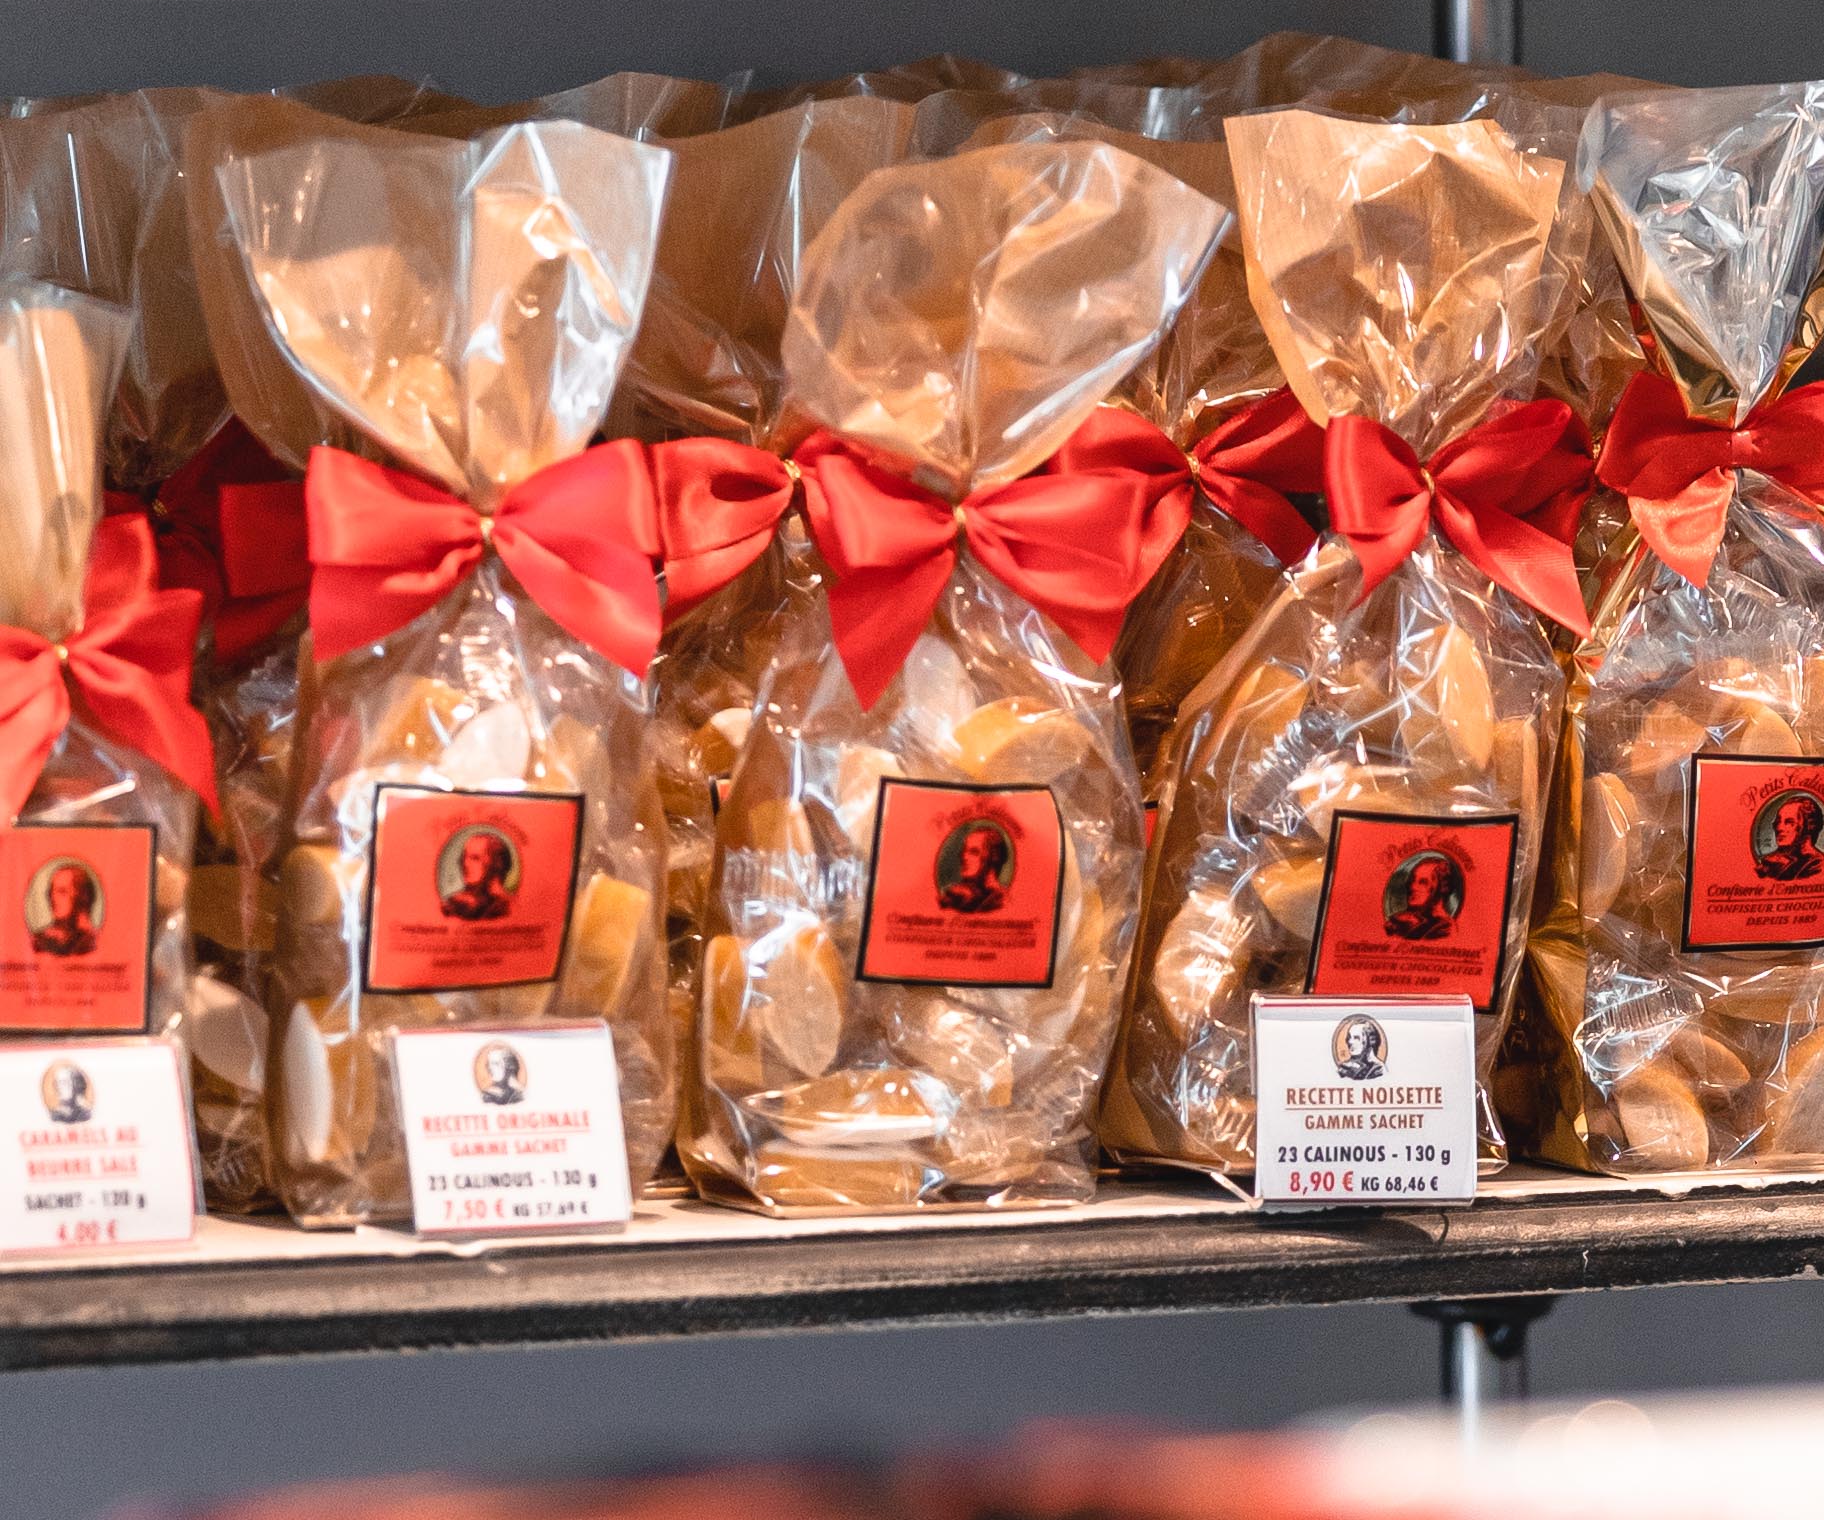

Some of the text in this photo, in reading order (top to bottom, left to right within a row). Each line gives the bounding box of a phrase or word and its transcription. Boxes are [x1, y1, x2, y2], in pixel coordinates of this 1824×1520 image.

[1741, 776, 1785, 812] Petits
[1707, 883, 1764, 901] Confiserie
[1707, 902, 1773, 914] CONFISEUR
[1746, 915, 1789, 926] DEPUIS
[1286, 1087, 1442, 1105] RECETTE NOISETTE
[422, 1111, 589, 1132] RECETTE ORIGINALE
[1305, 1114, 1424, 1130] GAMME SACHET
[451, 1139, 567, 1157] GAMME SACHET
[1278, 1146, 1297, 1162] 23
[1304, 1145, 1385, 1162] CALINOUS
[1405, 1145, 1435, 1162] 130
[1441, 1149, 1451, 1165] g
[455, 1172, 533, 1189] CALINOUS
[553, 1171, 581, 1186] 130
[1290, 1171, 1438, 1196] 8,90 € KG 68,46 €
[444, 1200, 488, 1222] 7,50
[495, 1199, 504, 1218] €
